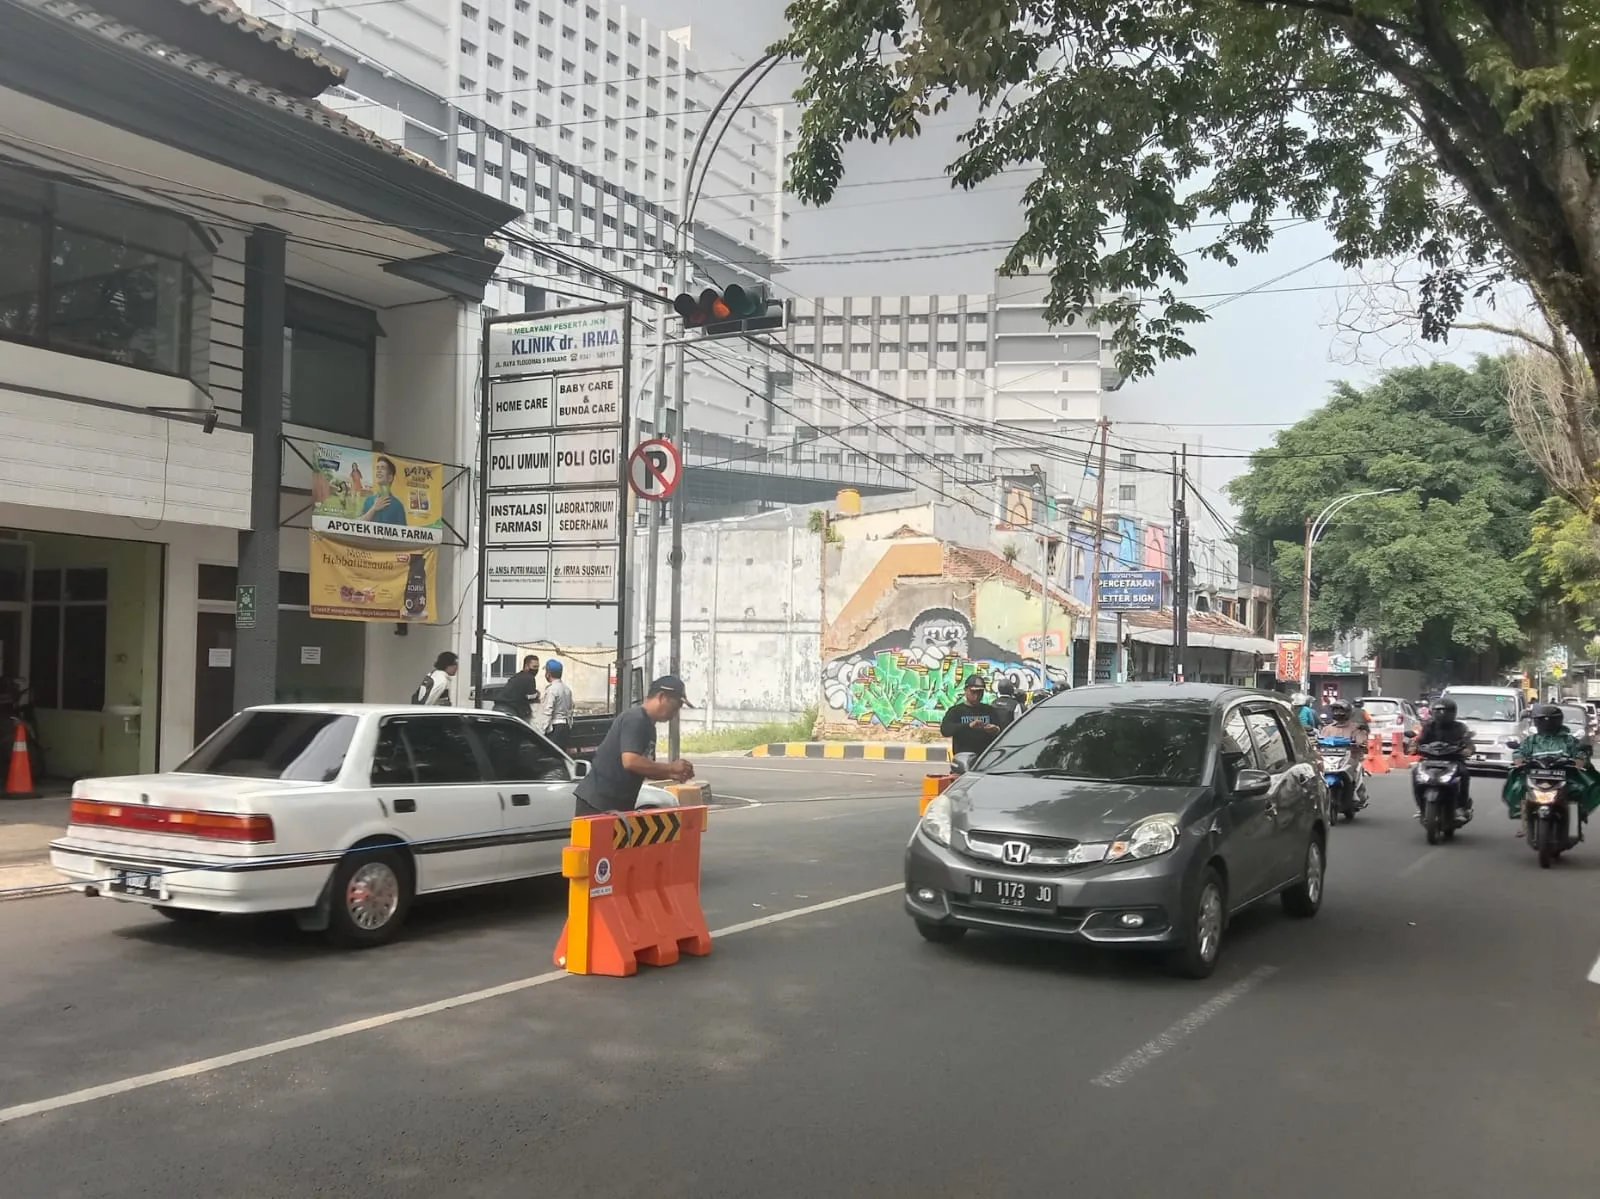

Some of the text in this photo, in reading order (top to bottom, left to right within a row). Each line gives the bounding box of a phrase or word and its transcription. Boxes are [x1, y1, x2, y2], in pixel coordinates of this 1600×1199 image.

[514, 323, 552, 335] MELAYANI
[553, 319, 588, 331] PESERTA
[511, 328, 619, 355] KLINIK dr. IRMA
[546, 355, 567, 363] MALANG
[559, 380, 614, 394] BABY CARE
[496, 397, 548, 413] HOME CARE
[583, 395, 590, 404] &
[559, 402, 616, 416] BUNDA CARE
[491, 452, 549, 471] POLI UMUM
[556, 448, 615, 468] POLI GIGI
[644, 450, 667, 489] P
[491, 503, 547, 517] INSTALASI
[555, 500, 614, 514] LABORATORIUM
[327, 519, 434, 541] APOTEK IRMA FARMA
[495, 520, 542, 533] FARMASI
[559, 518, 608, 531] SEDERHANA
[554, 564, 612, 576] dr. IRMA SUSWATI
[1098, 579, 1155, 588] PERCETAKAN
[1097, 594, 1155, 603] LETTER SIGN
[997, 881, 1026, 899] 1173
